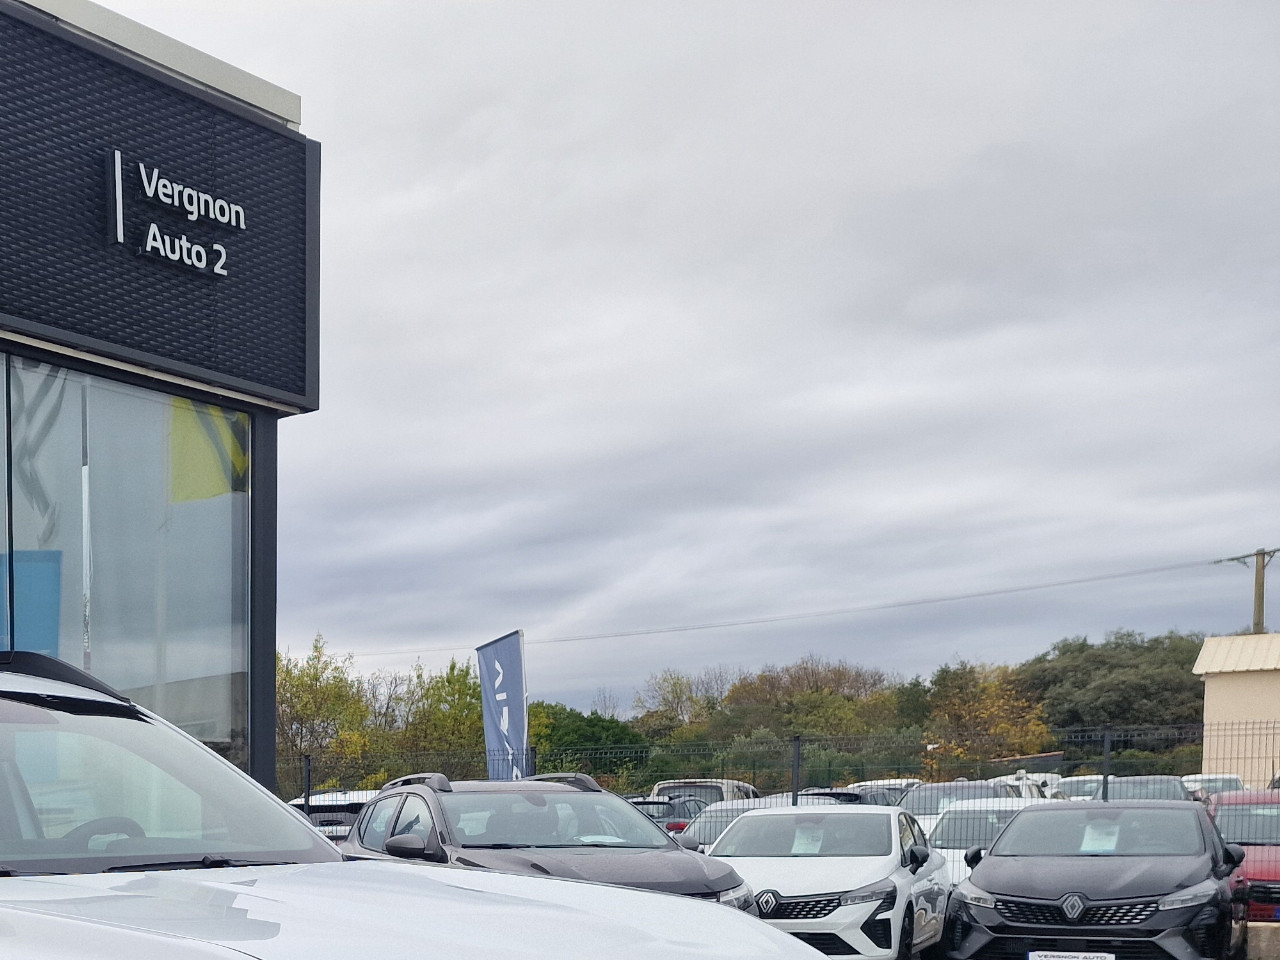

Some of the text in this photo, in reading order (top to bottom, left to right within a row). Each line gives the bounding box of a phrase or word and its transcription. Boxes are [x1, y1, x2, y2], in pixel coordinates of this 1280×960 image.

[139, 163, 246, 229] Vergnon
[146, 223, 227, 276] Auto 2
